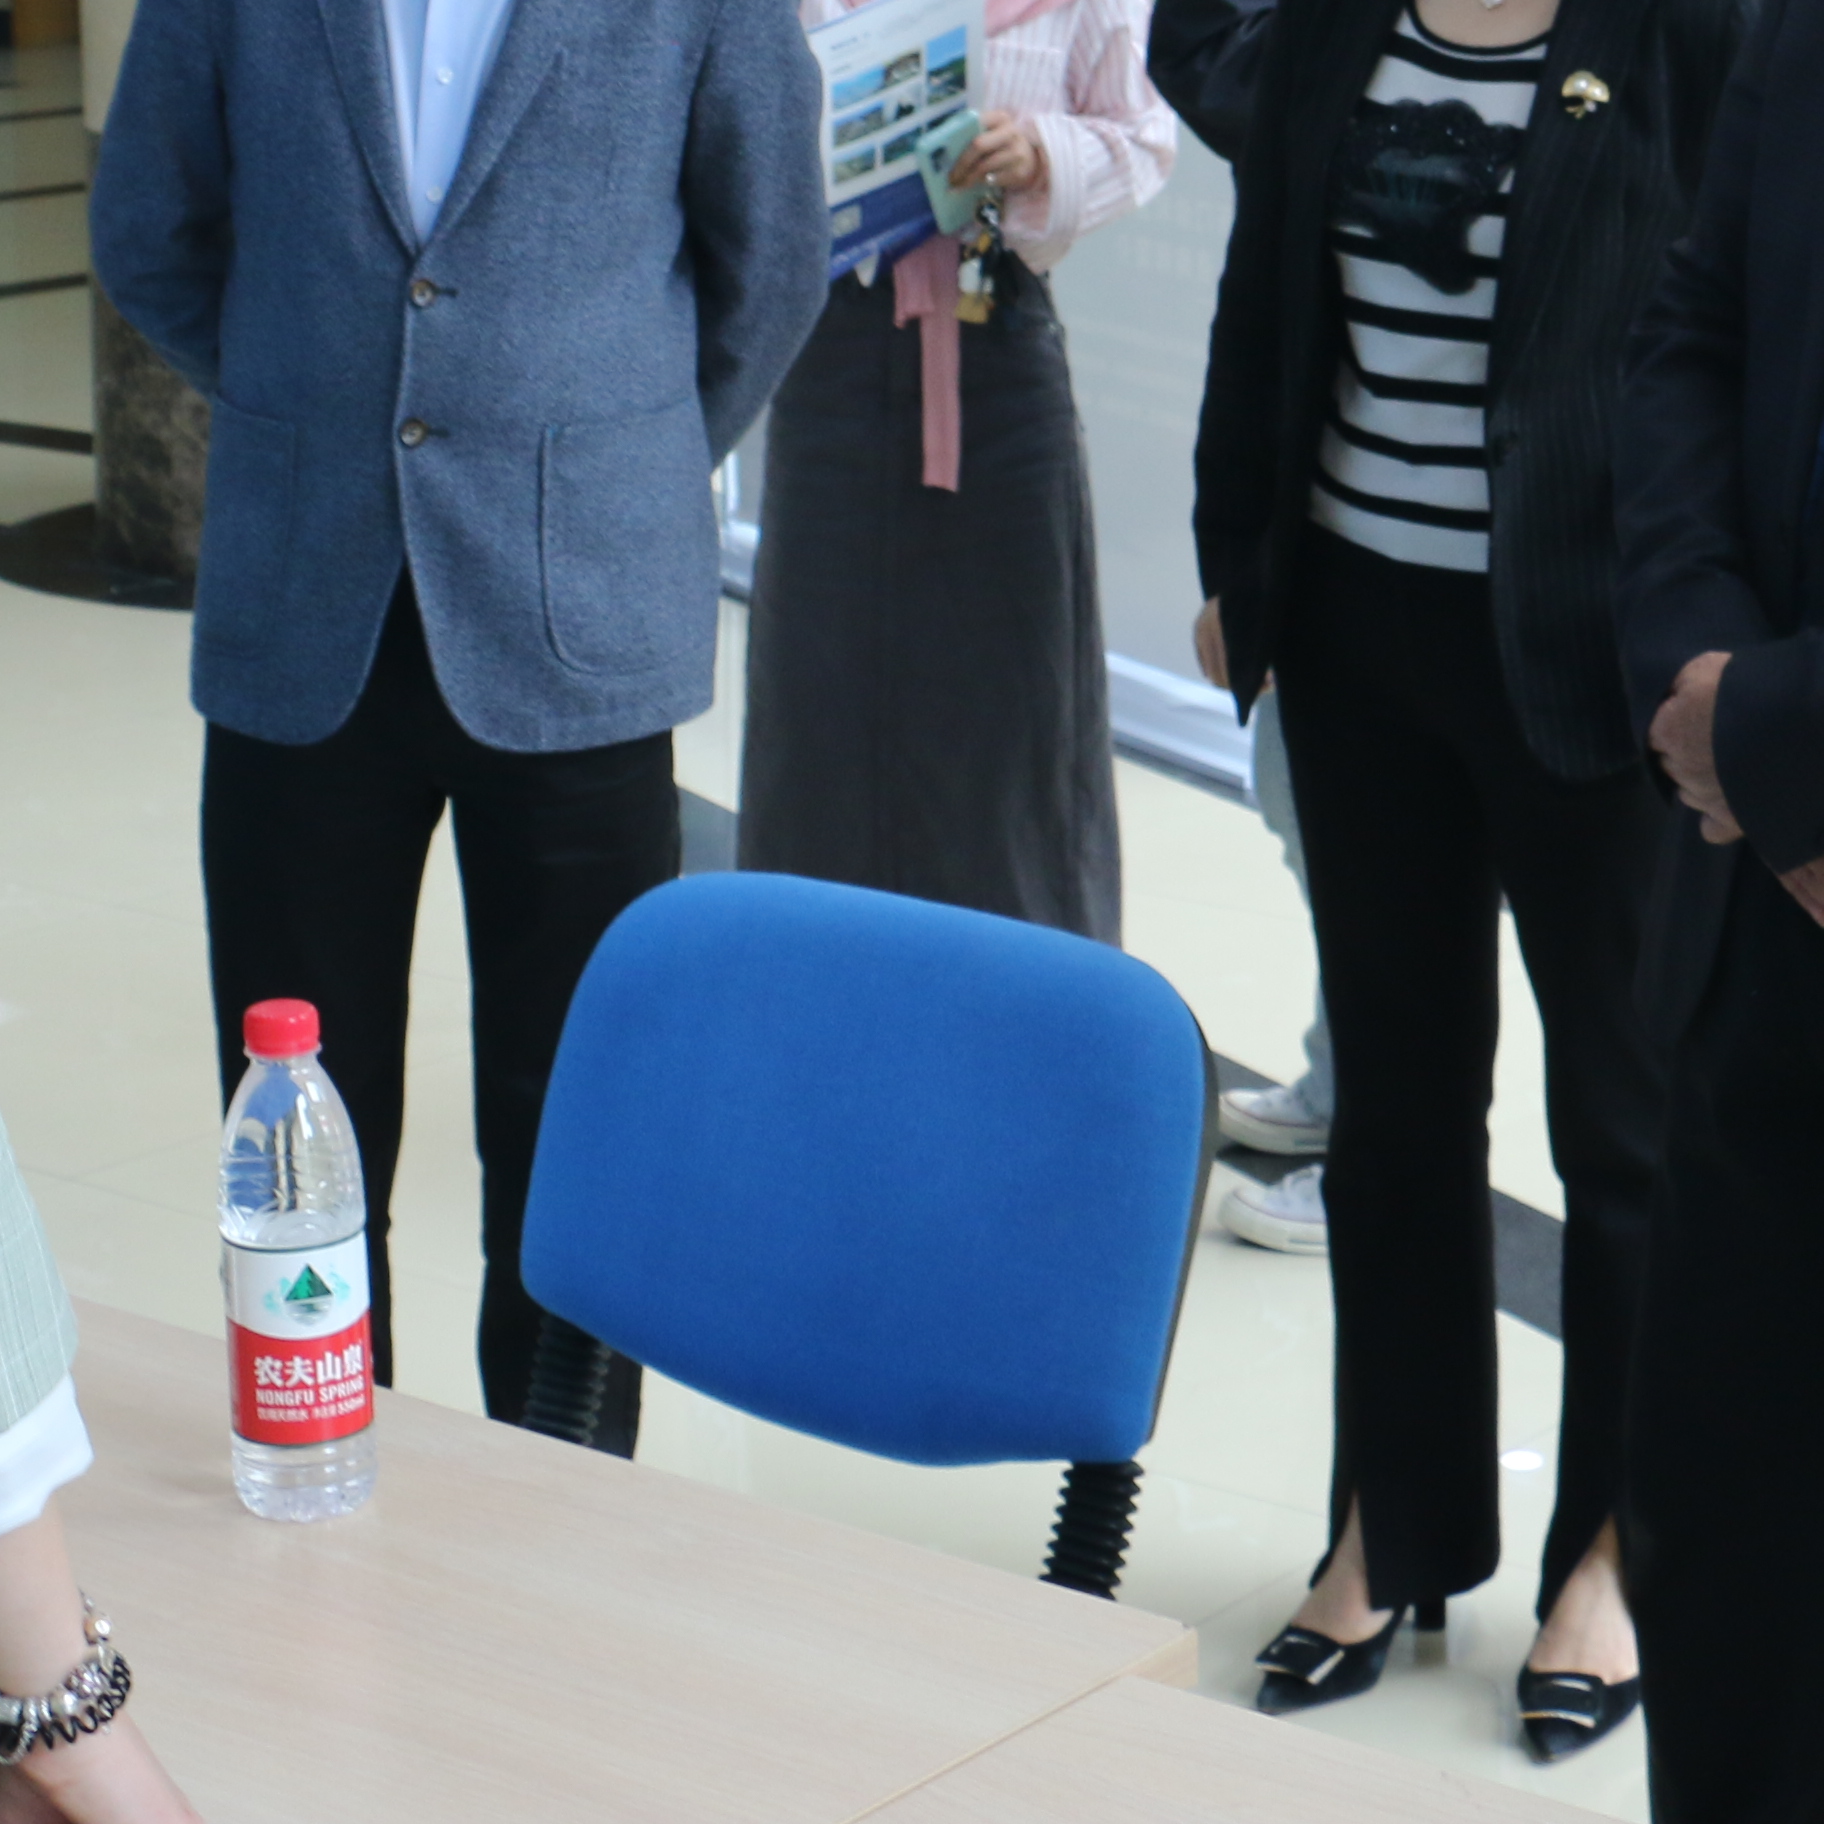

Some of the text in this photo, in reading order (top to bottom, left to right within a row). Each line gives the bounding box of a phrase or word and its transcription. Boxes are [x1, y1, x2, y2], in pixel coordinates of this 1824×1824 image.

[254, 1343, 364, 1387] 农夫山泉
[255, 1375, 364, 1407] NONGFU SPRING
